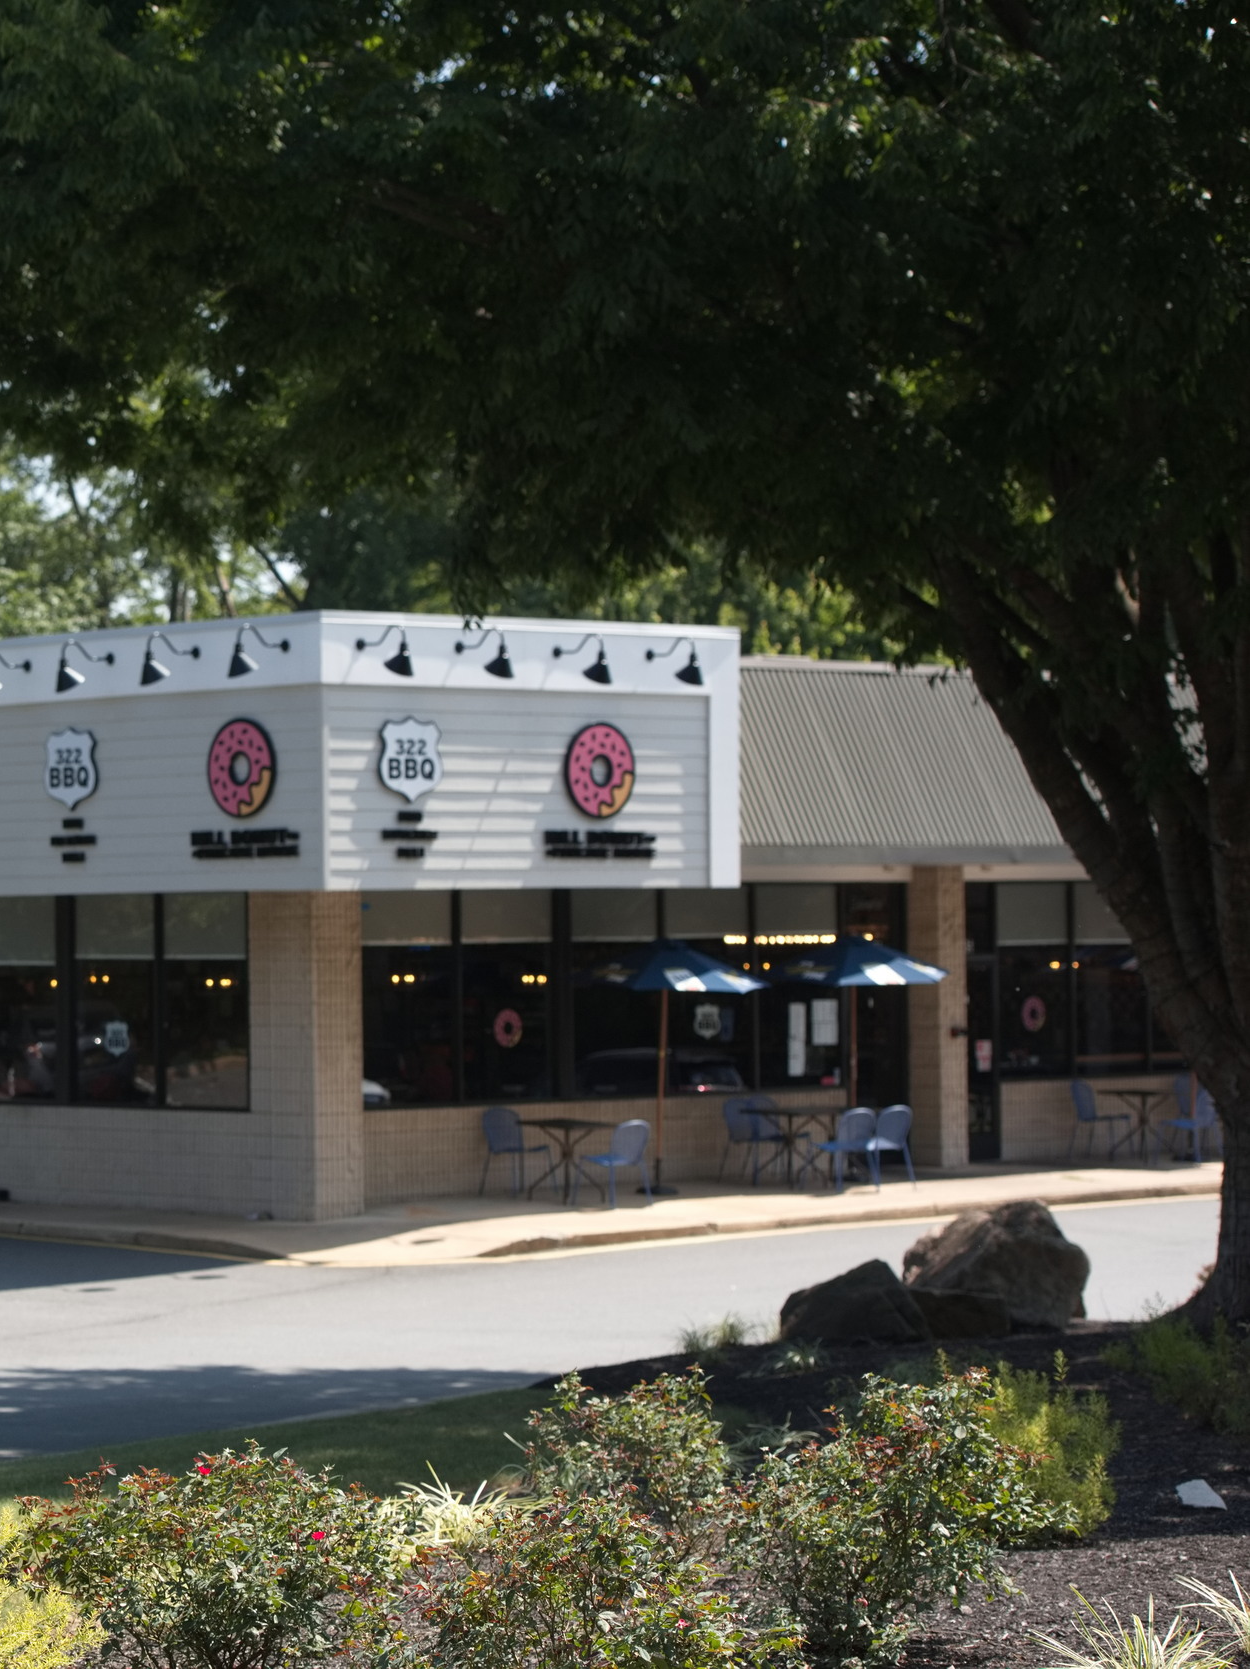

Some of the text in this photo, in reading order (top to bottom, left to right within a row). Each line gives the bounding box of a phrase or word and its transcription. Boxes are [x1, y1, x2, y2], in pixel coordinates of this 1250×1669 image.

[395, 739, 427, 756] 322
[50, 766, 89, 788] BBQ
[388, 758, 434, 780] BBQ
